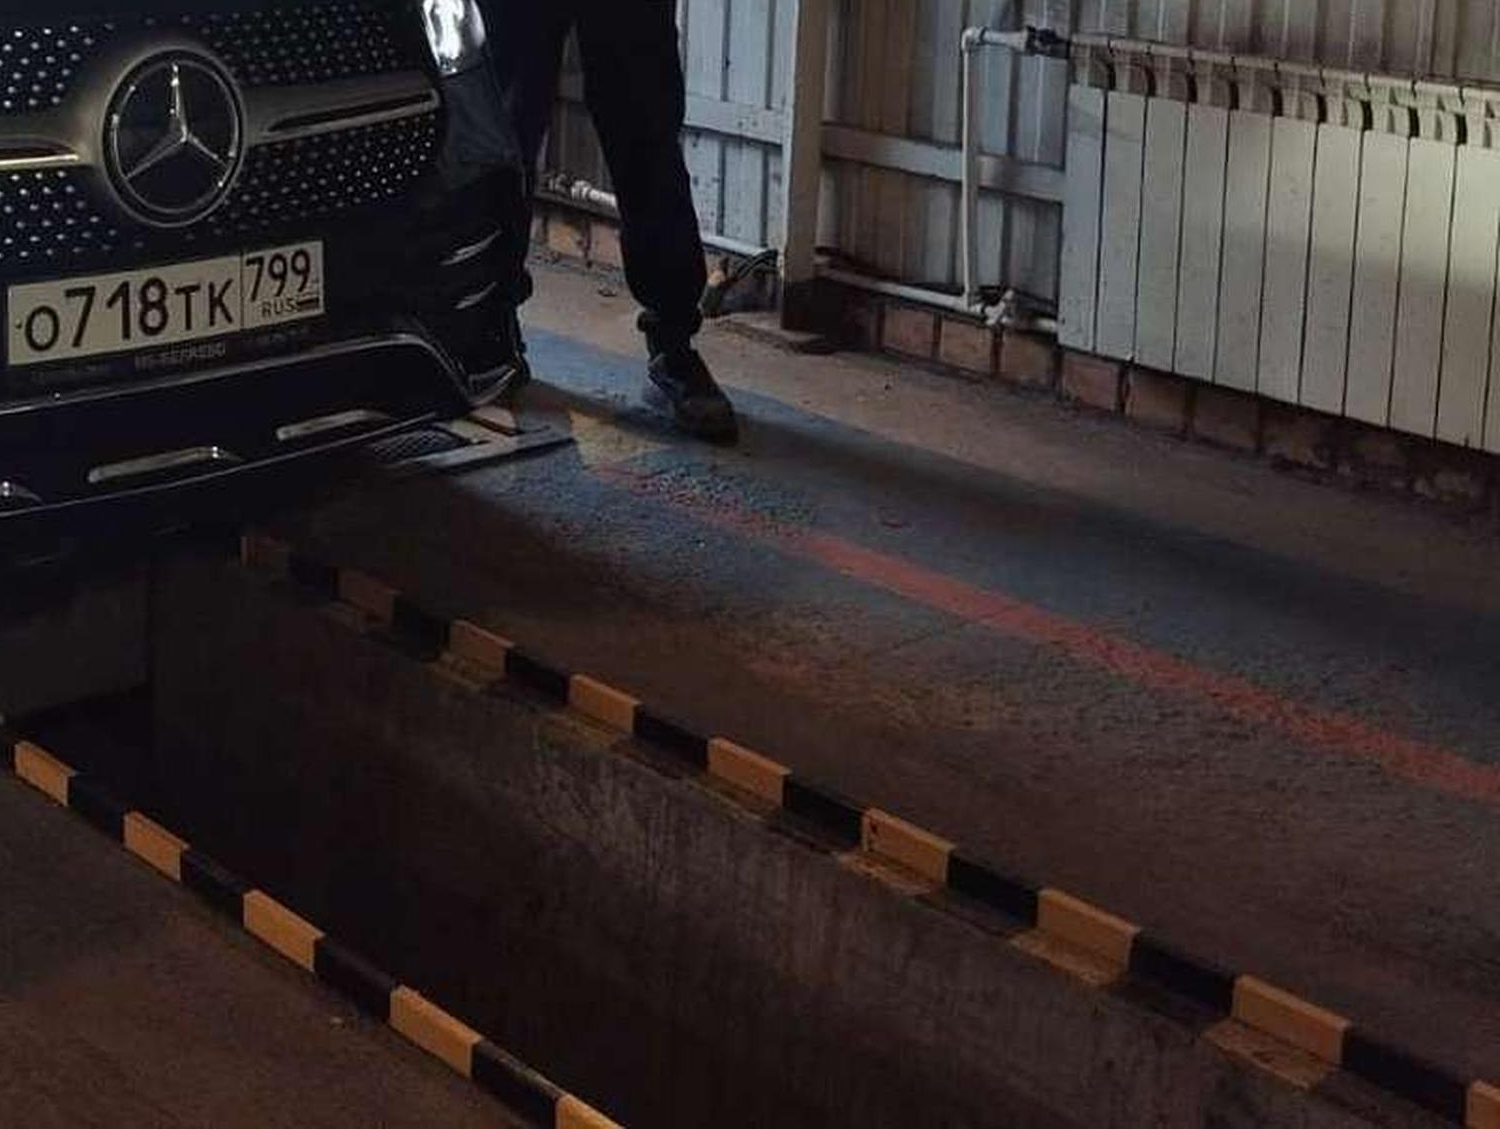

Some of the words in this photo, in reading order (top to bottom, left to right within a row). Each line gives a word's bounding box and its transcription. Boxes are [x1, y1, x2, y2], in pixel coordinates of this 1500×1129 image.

[245, 249, 311, 303] 799
[24, 276, 234, 352] O718TK
[261, 297, 297, 318] RUS
